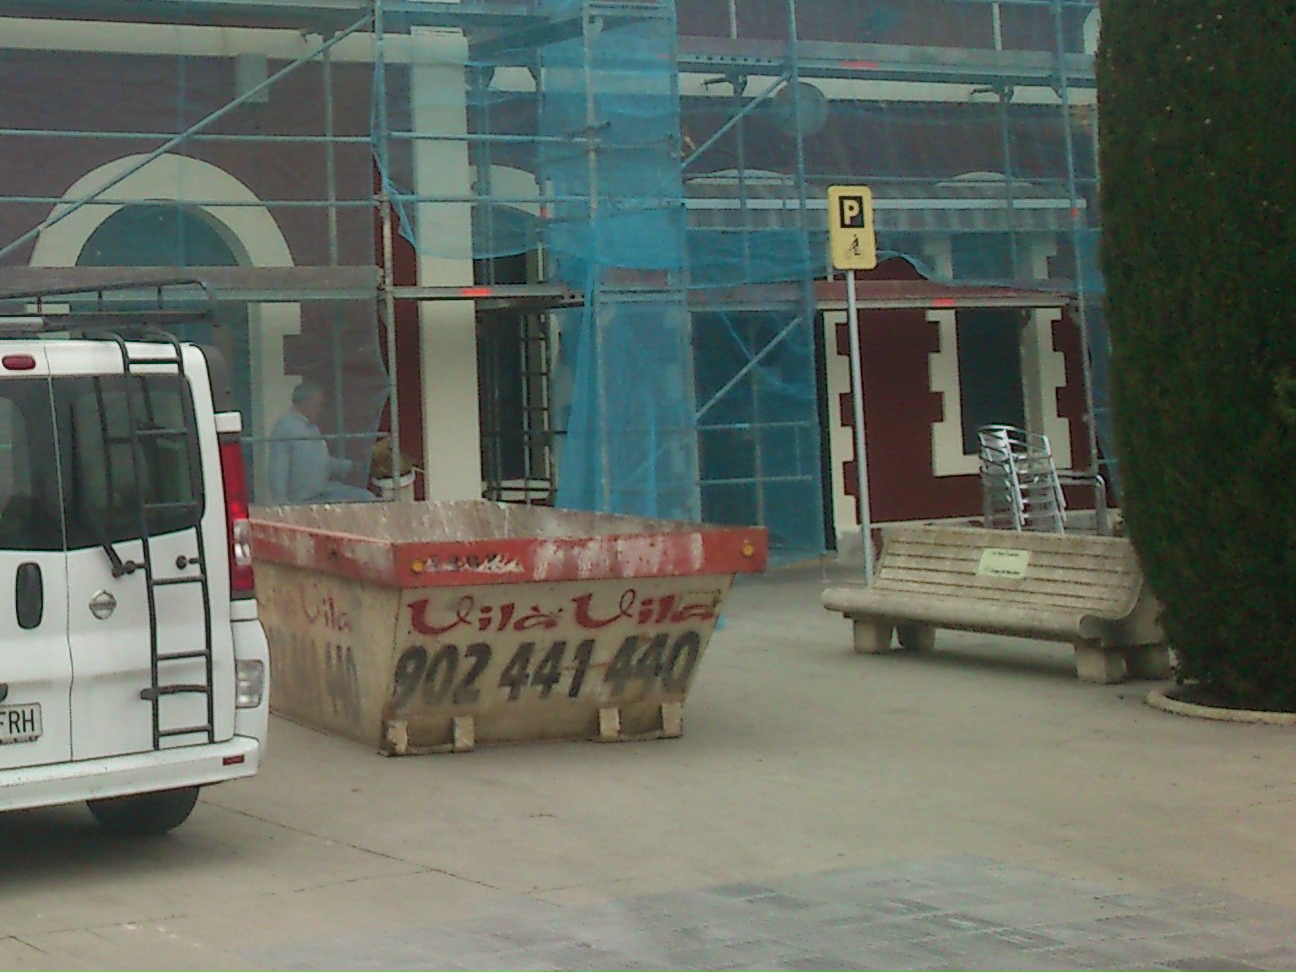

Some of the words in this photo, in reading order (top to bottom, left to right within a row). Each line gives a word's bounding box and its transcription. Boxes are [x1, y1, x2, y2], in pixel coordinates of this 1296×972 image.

[843, 199, 860, 225] P
[394, 641, 492, 708] 902
[498, 638, 595, 702] 441
[603, 630, 701, 696] 440
